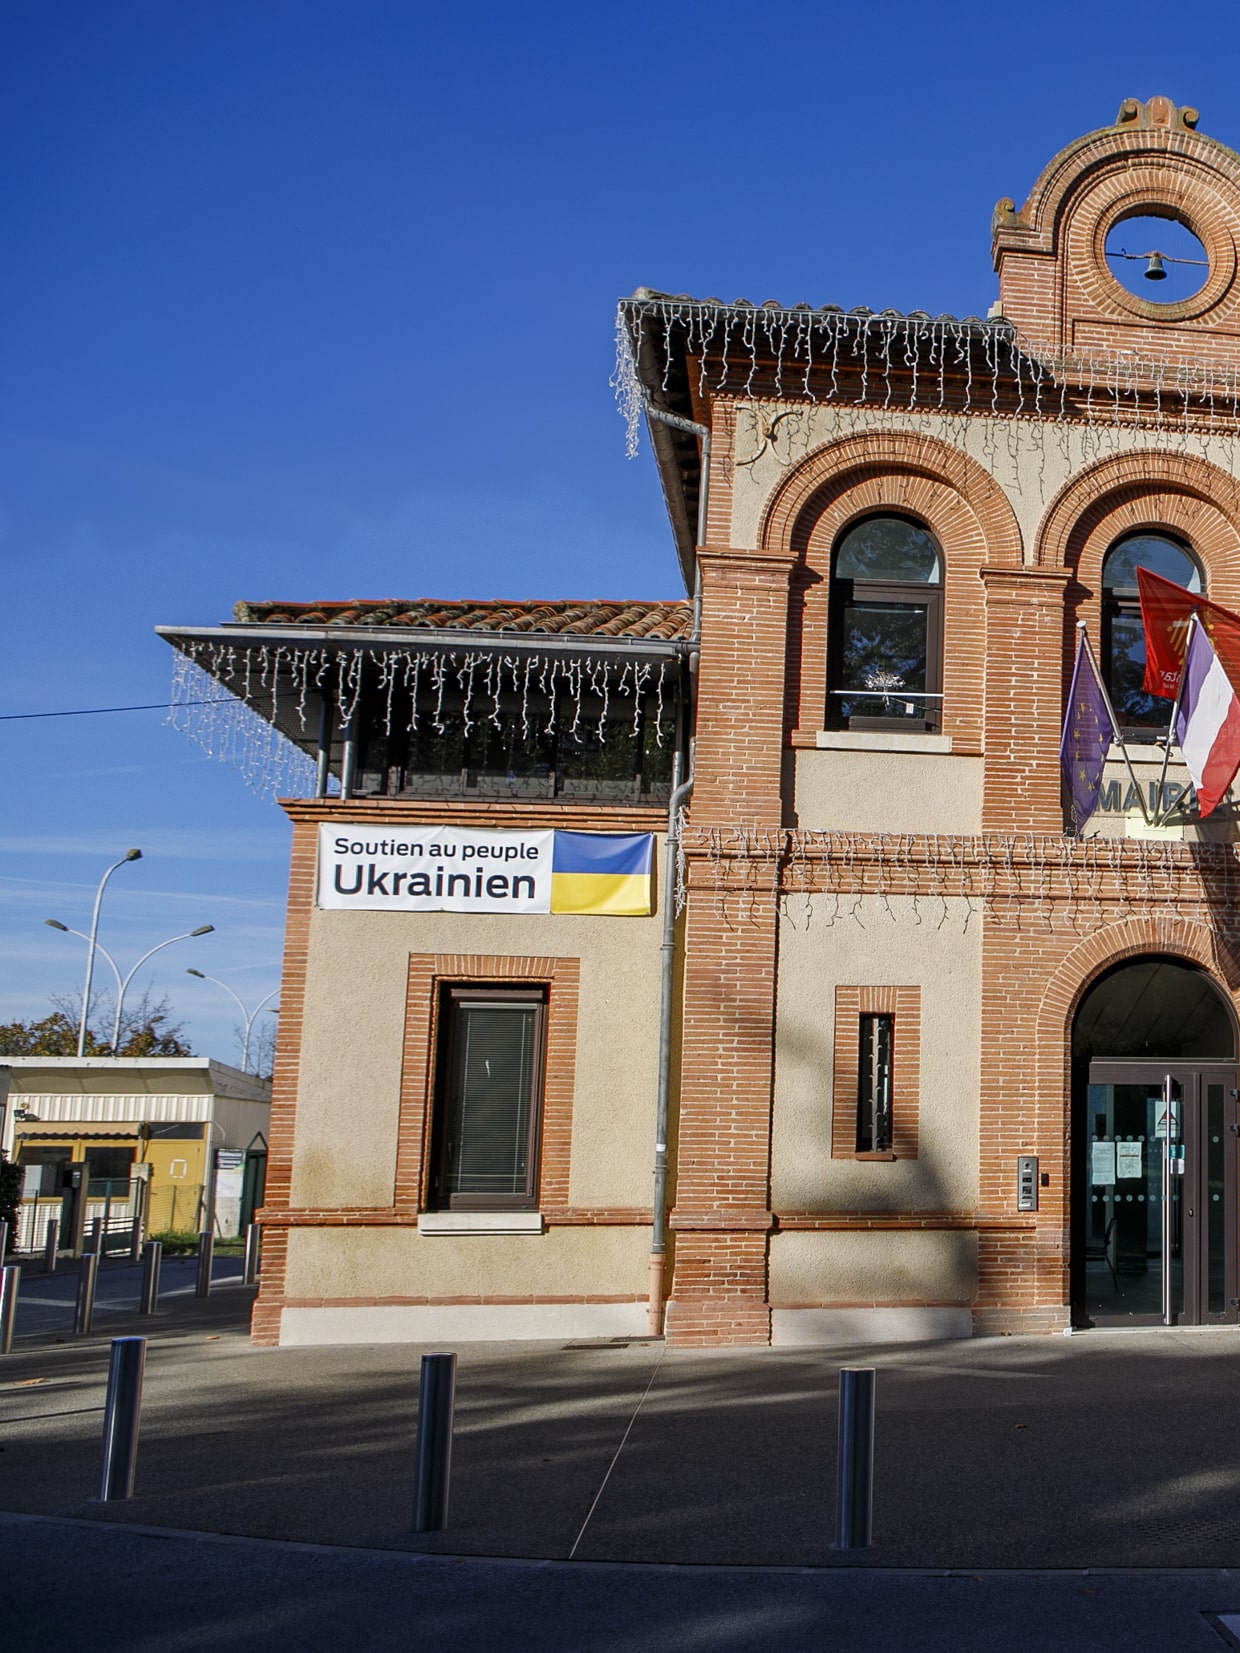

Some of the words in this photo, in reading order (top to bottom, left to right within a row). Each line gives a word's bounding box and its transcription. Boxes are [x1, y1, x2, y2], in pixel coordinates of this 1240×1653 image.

[334, 838, 423, 856] Soutien
[429, 843, 456, 857] au
[462, 842, 539, 862] peuple
[334, 863, 536, 899] Ukrainien
